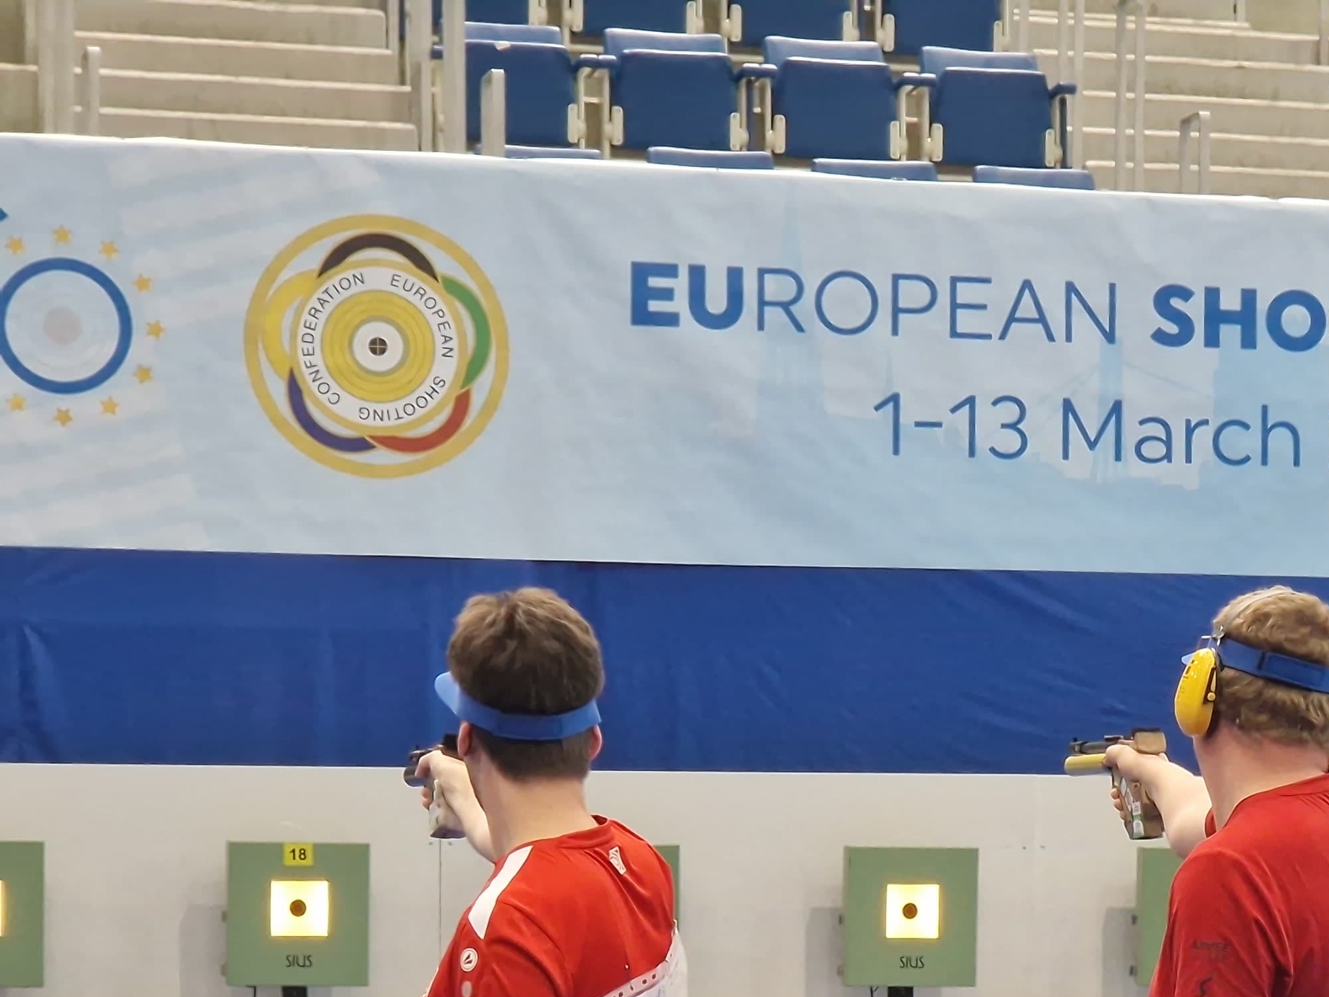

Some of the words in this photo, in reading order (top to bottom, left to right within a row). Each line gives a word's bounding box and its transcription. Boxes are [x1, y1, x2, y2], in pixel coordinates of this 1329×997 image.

[390, 273, 455, 359] EUROPEAN
[630, 260, 1117, 345] EUROPEAN
[301, 272, 366, 406] CONFEDERATION
[358, 375, 447, 423] SHOOTING
[1061, 397, 1300, 467] March
[288, 847, 307, 862] 18
[285, 954, 313, 968] SIUS
[899, 955, 925, 970] SIUS
